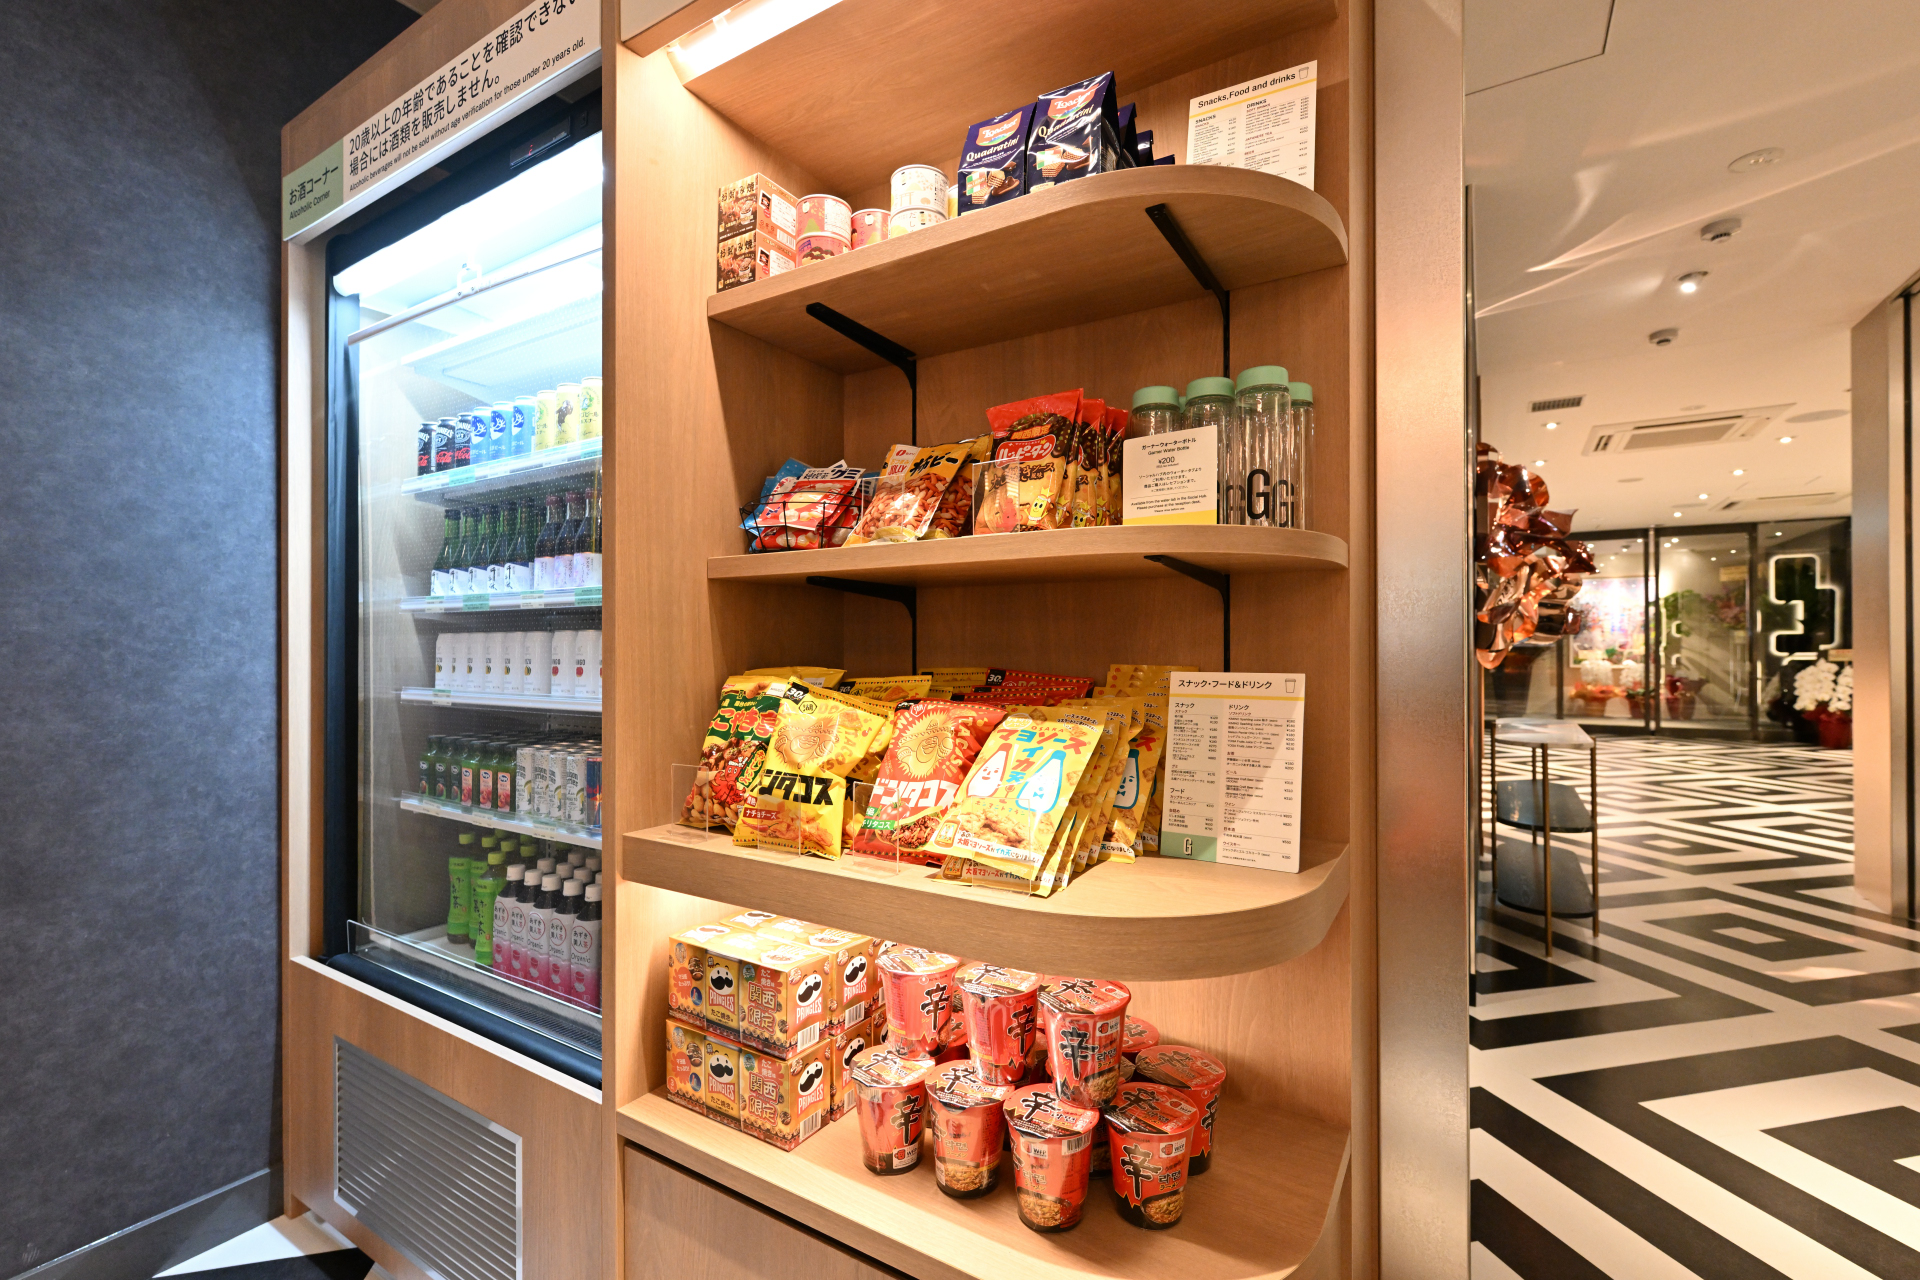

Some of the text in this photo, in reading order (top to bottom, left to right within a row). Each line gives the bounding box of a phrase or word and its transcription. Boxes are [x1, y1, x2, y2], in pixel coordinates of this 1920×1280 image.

[1251, 80, 1268, 92] and
[1269, 73, 1296, 86] drinks
[350, 37, 586, 192] Alcoholic beverages will not be sold without age verification for those under 20 years old.
[1246, 98, 1267, 109] DRINKS
[349, 69, 500, 177] 場合には酒類を販売しません。
[1195, 114, 1217, 125] SNACKS
[966, 134, 1020, 163] Quadratini
[289, 166, 339, 206] お酒コーナー
[289, 190, 331, 220] Alcoholic Corner
[998, 442, 1052, 466] ハッピーターン
[1141, 437, 1197, 450] ガーナーウォーターボトル
[888, 464, 907, 476] JOLLY
[1158, 456, 1176, 465] ¥200
[1247, 468, 1270, 519] G
[1272, 479, 1295, 528] G
[1178, 679, 1272, 690] スナック・フード&ドリンク
[997, 729, 1087, 755] マヨソース
[746, 809, 778, 820] ナチョチーズ
[1183, 837, 1193, 857] G
[494, 906, 505, 915] あずき
[494, 914, 506, 923] 美人茶
[511, 911, 523, 920] あずき
[529, 917, 542, 926] あずき
[511, 919, 523, 928] 美人茶
[529, 925, 542, 935] 美人茶
[551, 922, 563, 933] あずき
[527, 938, 544, 950] Organic
[551, 931, 563, 941] 美人茶
[573, 930, 588, 940] あずき
[573, 939, 588, 949] 美人茶
[570, 952, 591, 964] Organic
[709, 988, 735, 1013] PRINGLES
[749, 982, 778, 1013] 関西
[843, 978, 867, 1003] PRINGLES
[796, 998, 823, 1024] PRINGLES
[920, 982, 950, 1033] 辛
[747, 1005, 777, 1034] 限定
[1007, 1004, 1036, 1056] 辛
[1059, 1026, 1099, 1081] 辛
[708, 1076, 735, 1102] PRINGLES
[749, 1072, 778, 1103] 関西
[747, 1096, 777, 1123] 限定
[798, 1085, 824, 1115] PRINGLES
[1021, 1090, 1062, 1121] 辛
[891, 1094, 924, 1146] 辛
[944, 1138, 969, 1152] 라면
[1022, 1169, 1047, 1185] 라면
[1120, 1143, 1163, 1200] 辛
[1158, 1169, 1182, 1185] 라면
